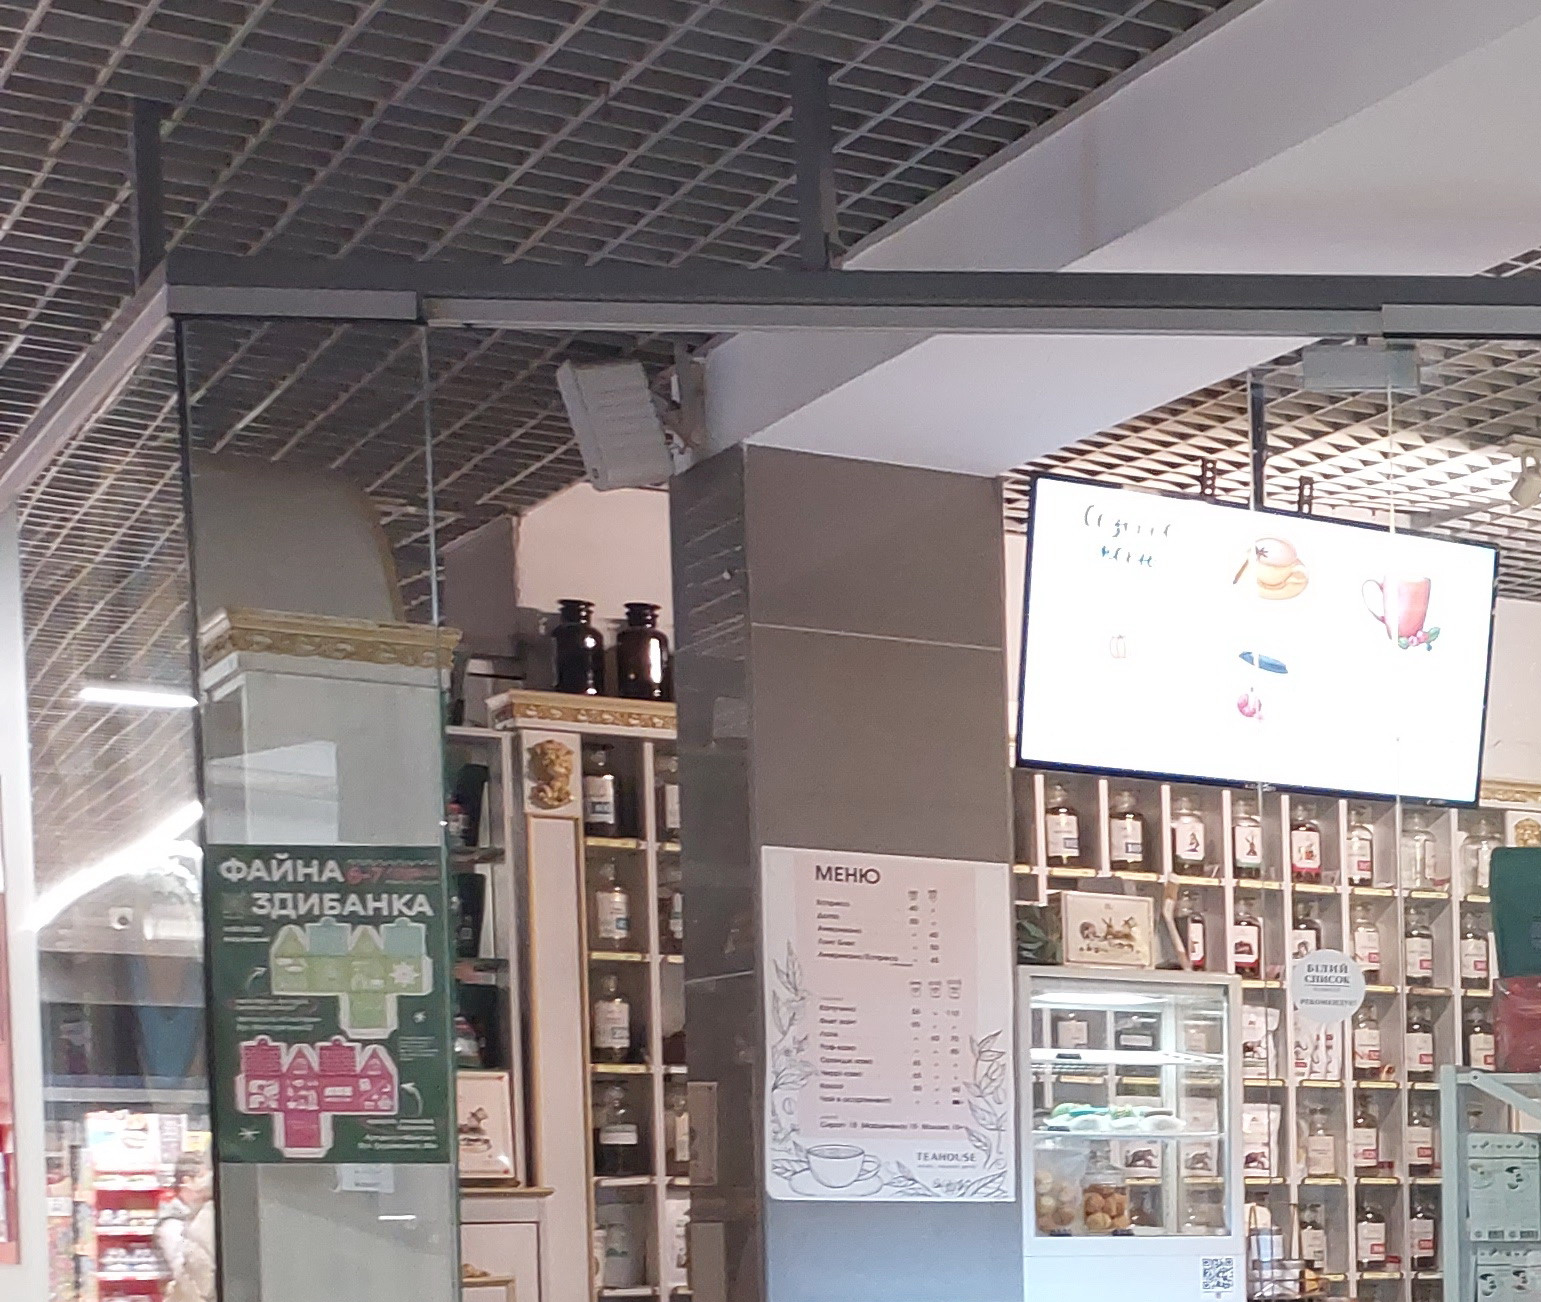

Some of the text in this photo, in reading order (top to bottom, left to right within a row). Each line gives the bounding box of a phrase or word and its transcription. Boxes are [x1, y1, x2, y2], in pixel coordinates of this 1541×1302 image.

[219, 853, 345, 882] ФАЙНА
[815, 865, 881, 885] МЕНЮ
[251, 892, 435, 919] ЗДИБАНКА
[1306, 963, 1349, 974] БІЛИЙ
[1304, 974, 1351, 985] СПИСОК
